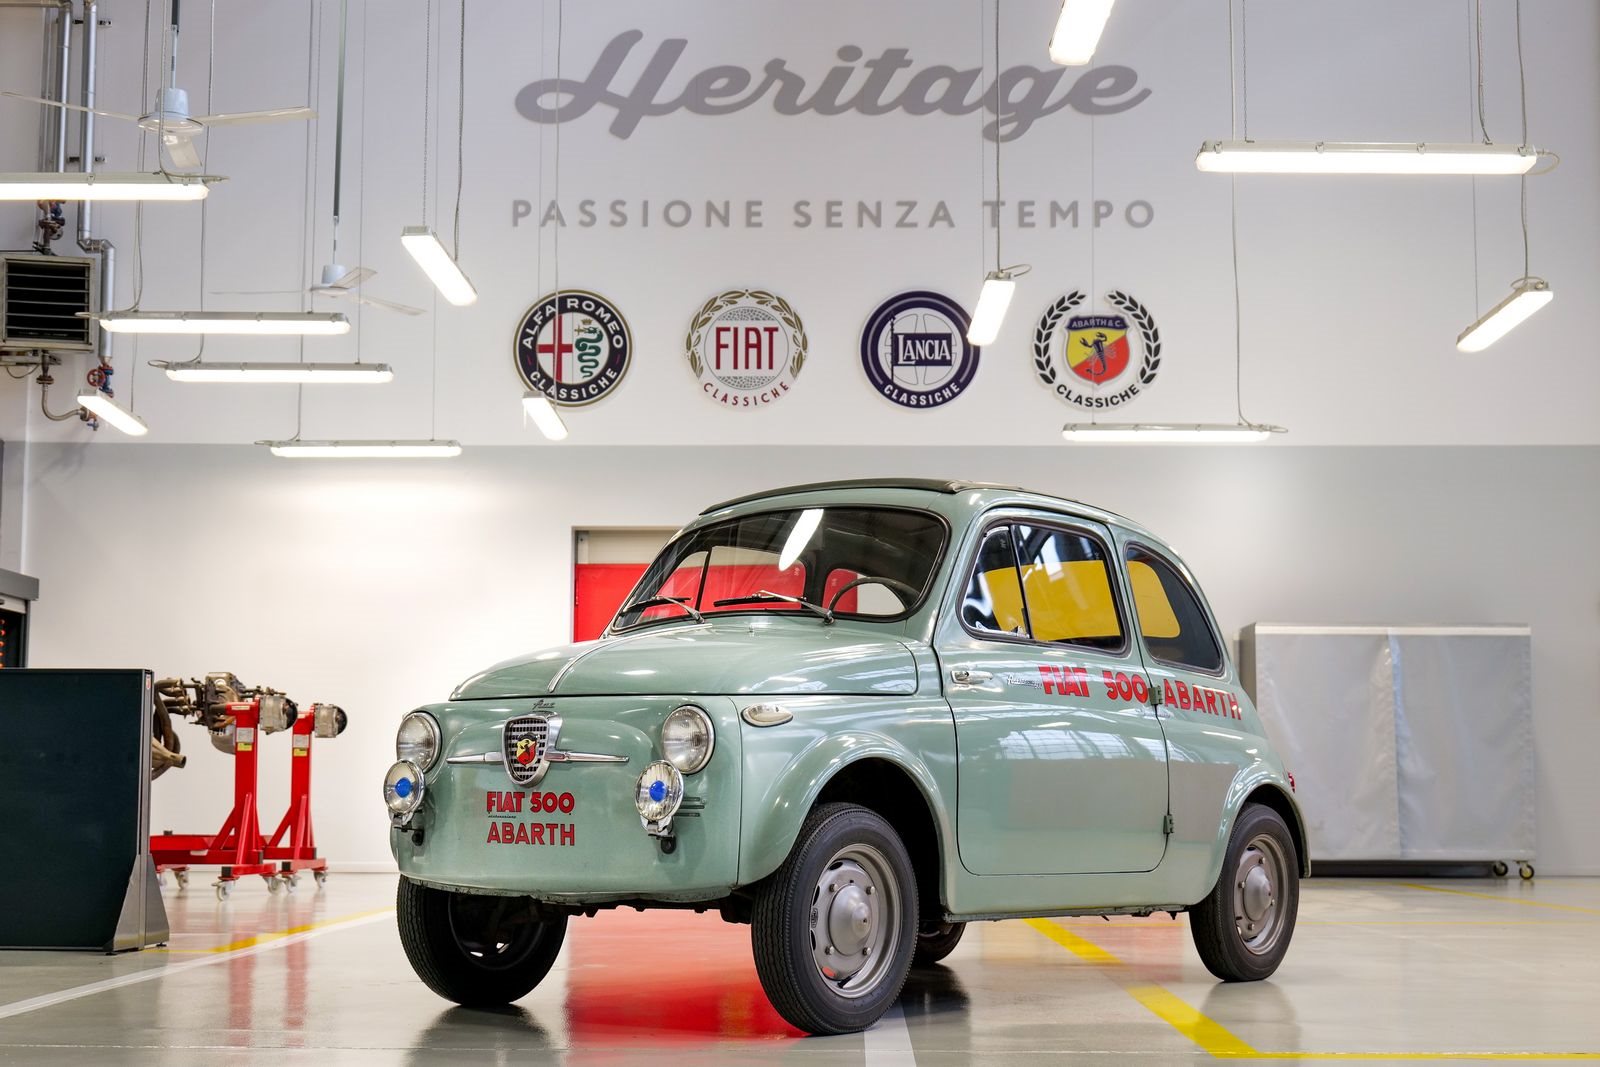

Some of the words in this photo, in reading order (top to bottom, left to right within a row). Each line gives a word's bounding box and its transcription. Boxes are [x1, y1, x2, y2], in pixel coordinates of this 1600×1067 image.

[514, 29, 1153, 143] Heritage
[512, 199, 763, 229] PASSIONE
[793, 199, 956, 229] SENZA
[982, 199, 1155, 229] TEMPO
[522, 304, 556, 349] ALFA
[566, 298, 623, 349] ROMEO
[1071, 318, 1107, 328] ABARTH
[715, 326, 779, 370] FIAT
[530, 368, 617, 400] CLASSICHE
[703, 380, 789, 407] CLASSICHE
[883, 381, 961, 406] CLASSICHE
[1056, 383, 1140, 408] CLASSICHE
[1038, 665, 1091, 698] FIAT
[1102, 669, 1149, 704] 500
[1162, 678, 1242, 721] ABARTH
[486, 791, 526, 813] FIAT
[530, 791, 575, 814] 500
[486, 821, 575, 846] ABARTH
